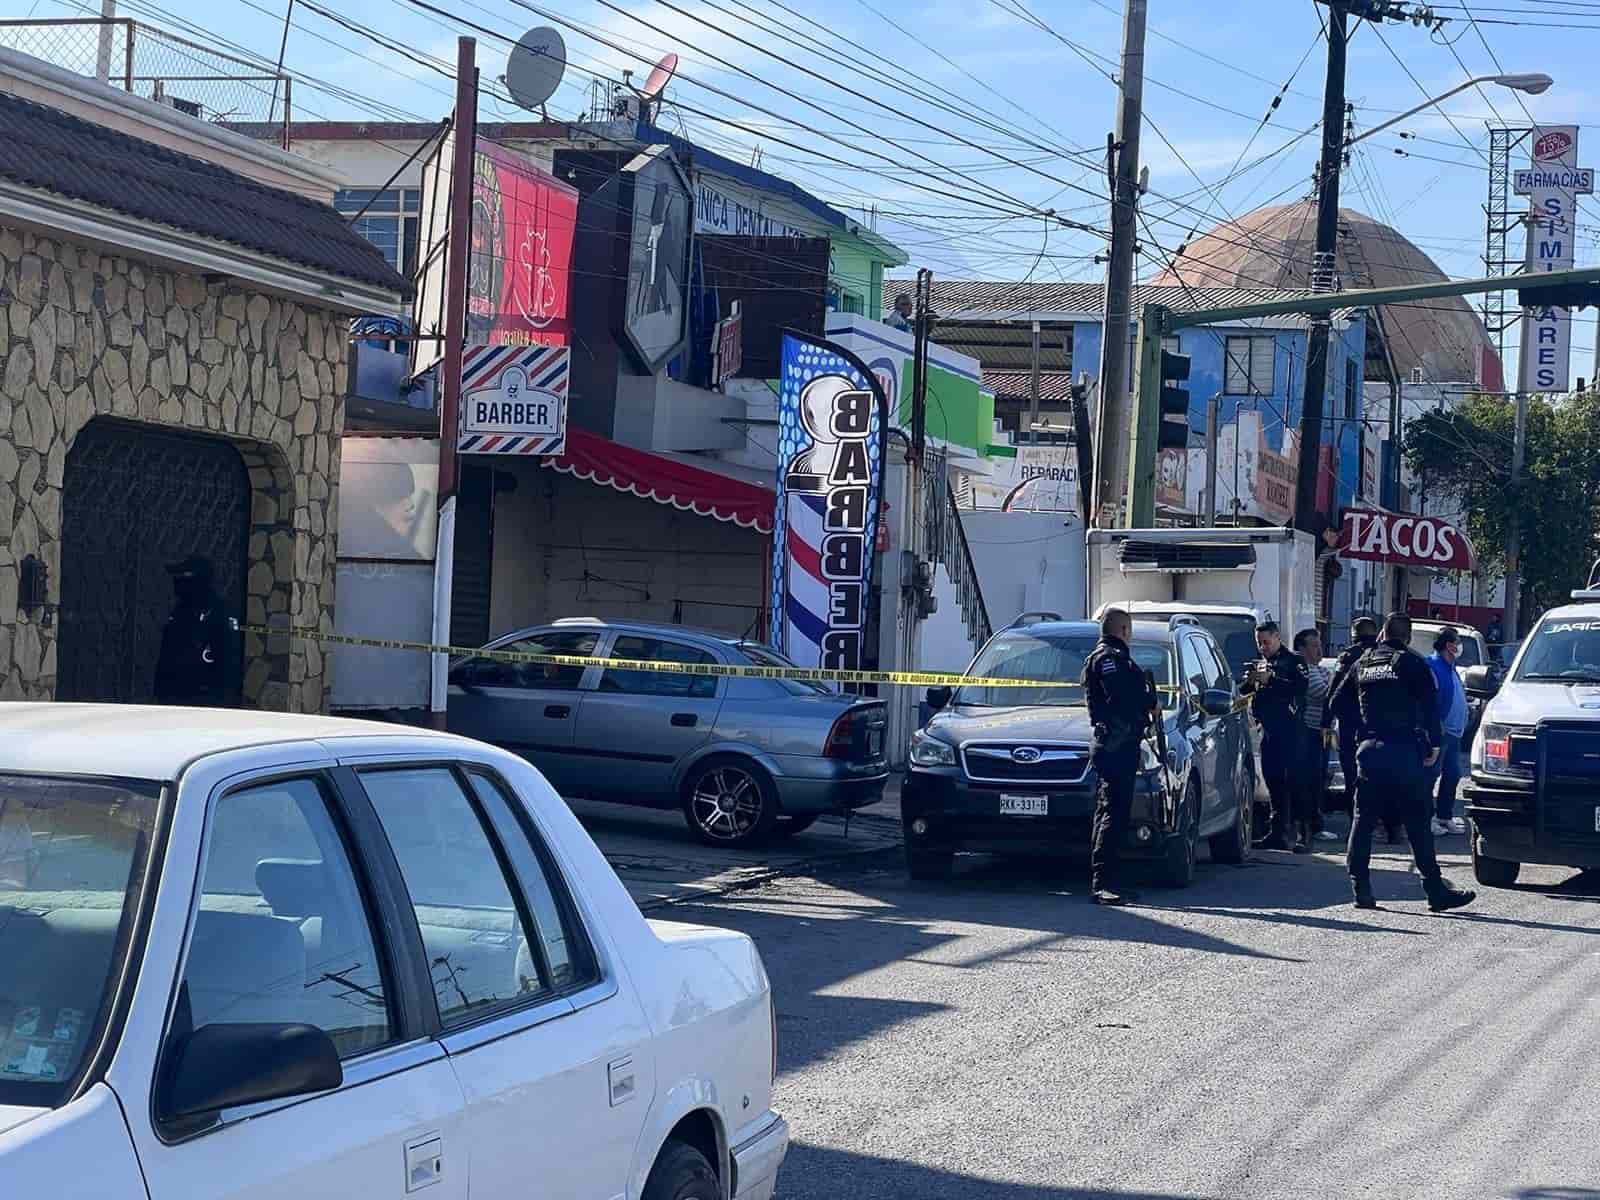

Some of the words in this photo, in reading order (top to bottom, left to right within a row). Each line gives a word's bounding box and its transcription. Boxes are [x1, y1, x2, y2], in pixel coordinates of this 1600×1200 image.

[1519, 172, 1589, 189] FARMACIAS
[1536, 198, 1563, 389] SIMIARES
[476, 401, 548, 425] BARBER
[1344, 512, 1456, 562] TACOS
